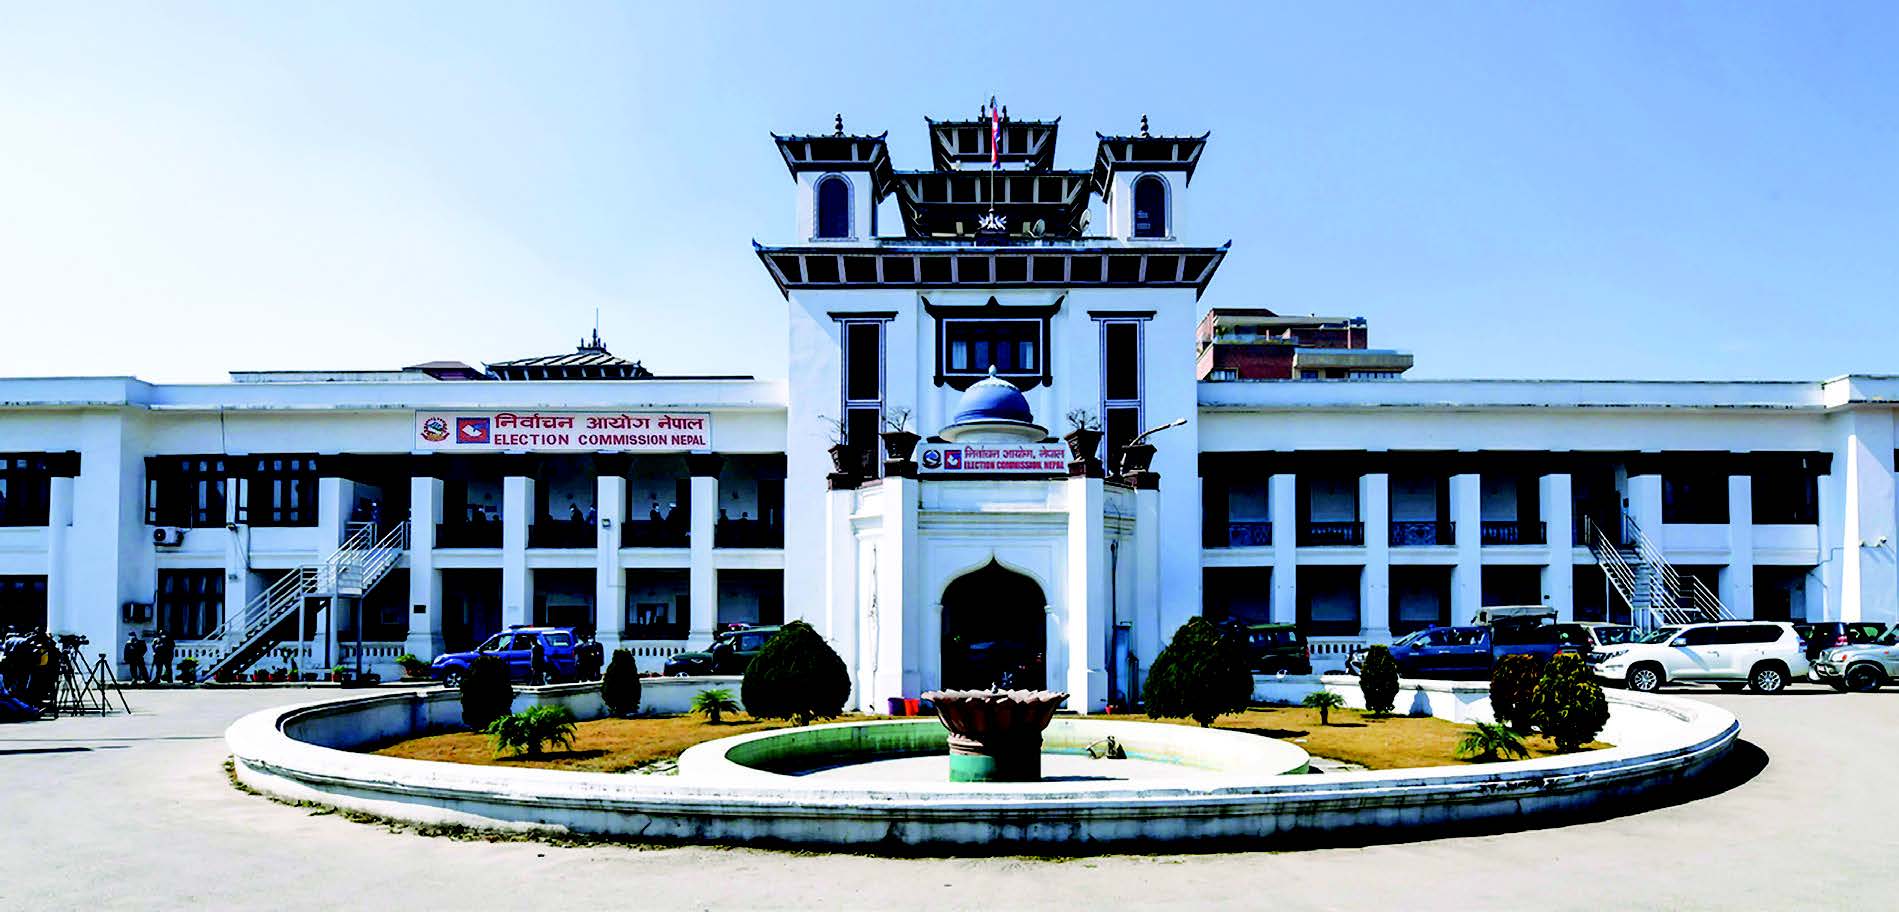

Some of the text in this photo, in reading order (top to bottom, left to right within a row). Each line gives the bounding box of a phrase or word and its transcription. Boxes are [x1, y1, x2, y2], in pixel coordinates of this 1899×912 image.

[494, 412, 704, 430] निर्वाचन आयोग नेपाल
[494, 434, 706, 446] ELECTION COMMISSION NEPAL
[964, 446, 999, 459] निर्वाचन
[964, 461, 994, 469] ELECTION
[1044, 461, 1064, 469] NEPAL
